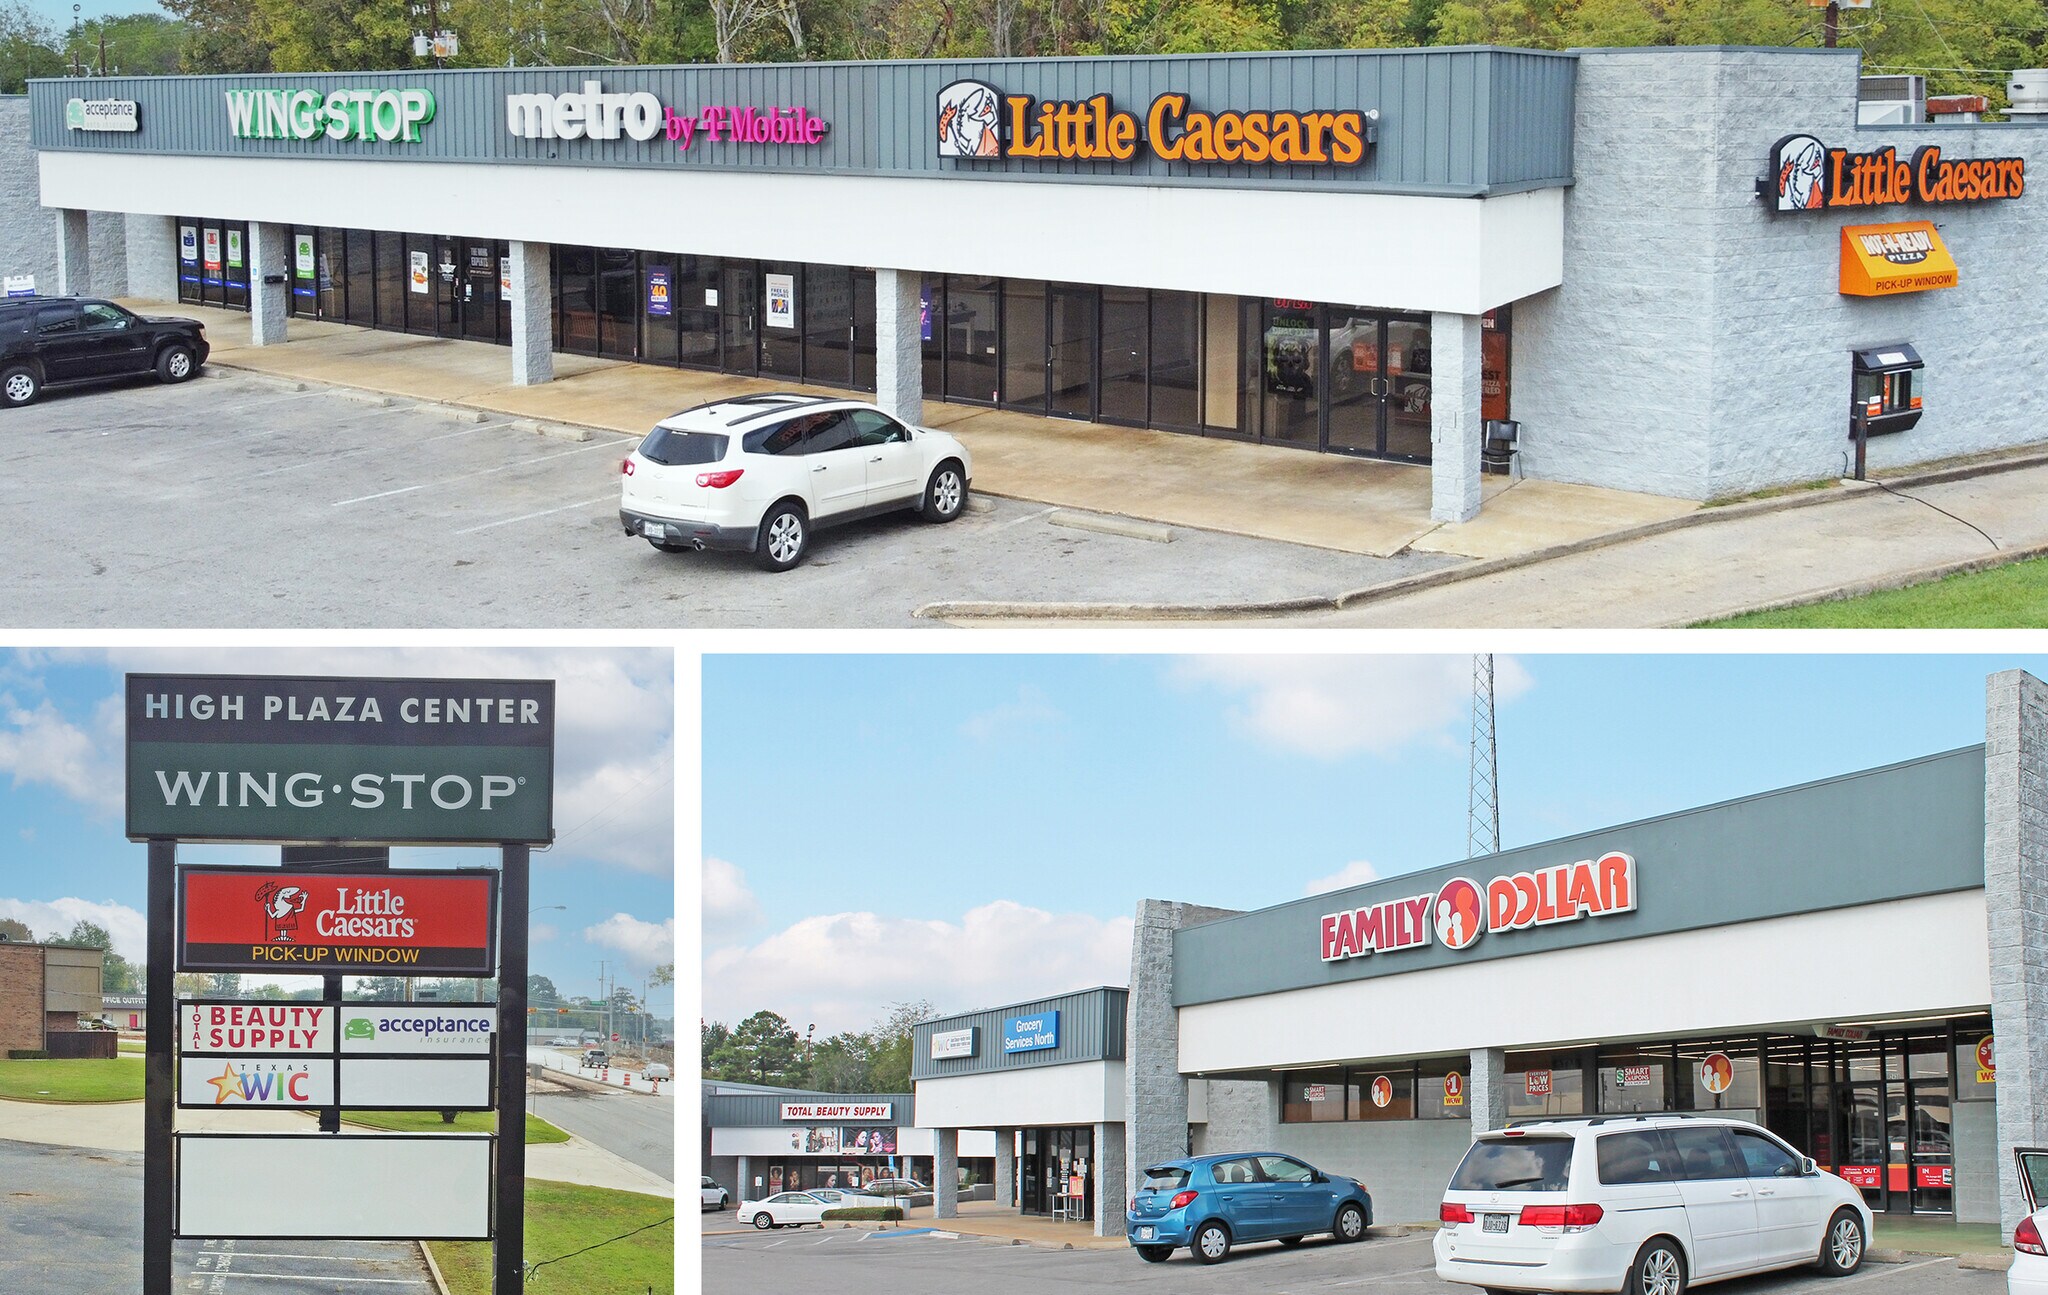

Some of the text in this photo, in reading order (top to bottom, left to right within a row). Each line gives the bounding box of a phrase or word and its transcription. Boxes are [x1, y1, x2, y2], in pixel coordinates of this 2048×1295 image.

[85, 102, 133, 119] acceptance
[507, 80, 663, 141] metro
[663, 106, 698, 151] by
[1006, 93, 1136, 160] Little
[1828, 146, 2024, 206] Little Caesars
[1888, 252, 1925, 262] PIZZA
[1876, 275, 1953, 291] PICK-UP WINDOW
[146, 693, 540, 725] HIGH PLAZA CENTER
[336, 887, 405, 915] Little
[1321, 855, 1630, 960] FAMILY DOLLAR
[252, 946, 420, 963] PICK-UP WINDOW
[211, 1006, 324, 1027] BEAUTY
[1016, 1019, 1044, 1033] Grocery
[192, 1004, 202, 1050] TOTAL
[378, 1016, 490, 1037] acceptance
[209, 1028, 319, 1049] SUPPLY
[1005, 1031, 1055, 1050] Services North
[240, 1064, 308, 1072] TEXAS
[1624, 1067, 1649, 1076] SMART
[240, 1072, 309, 1101] WIC
[1446, 1075, 1458, 1093] $1
[1529, 1076, 1549, 1085] LOW
[1529, 1084, 1549, 1092] PRICES
[787, 1106, 887, 1116] TOTAL BEAUTY SUPPLY
